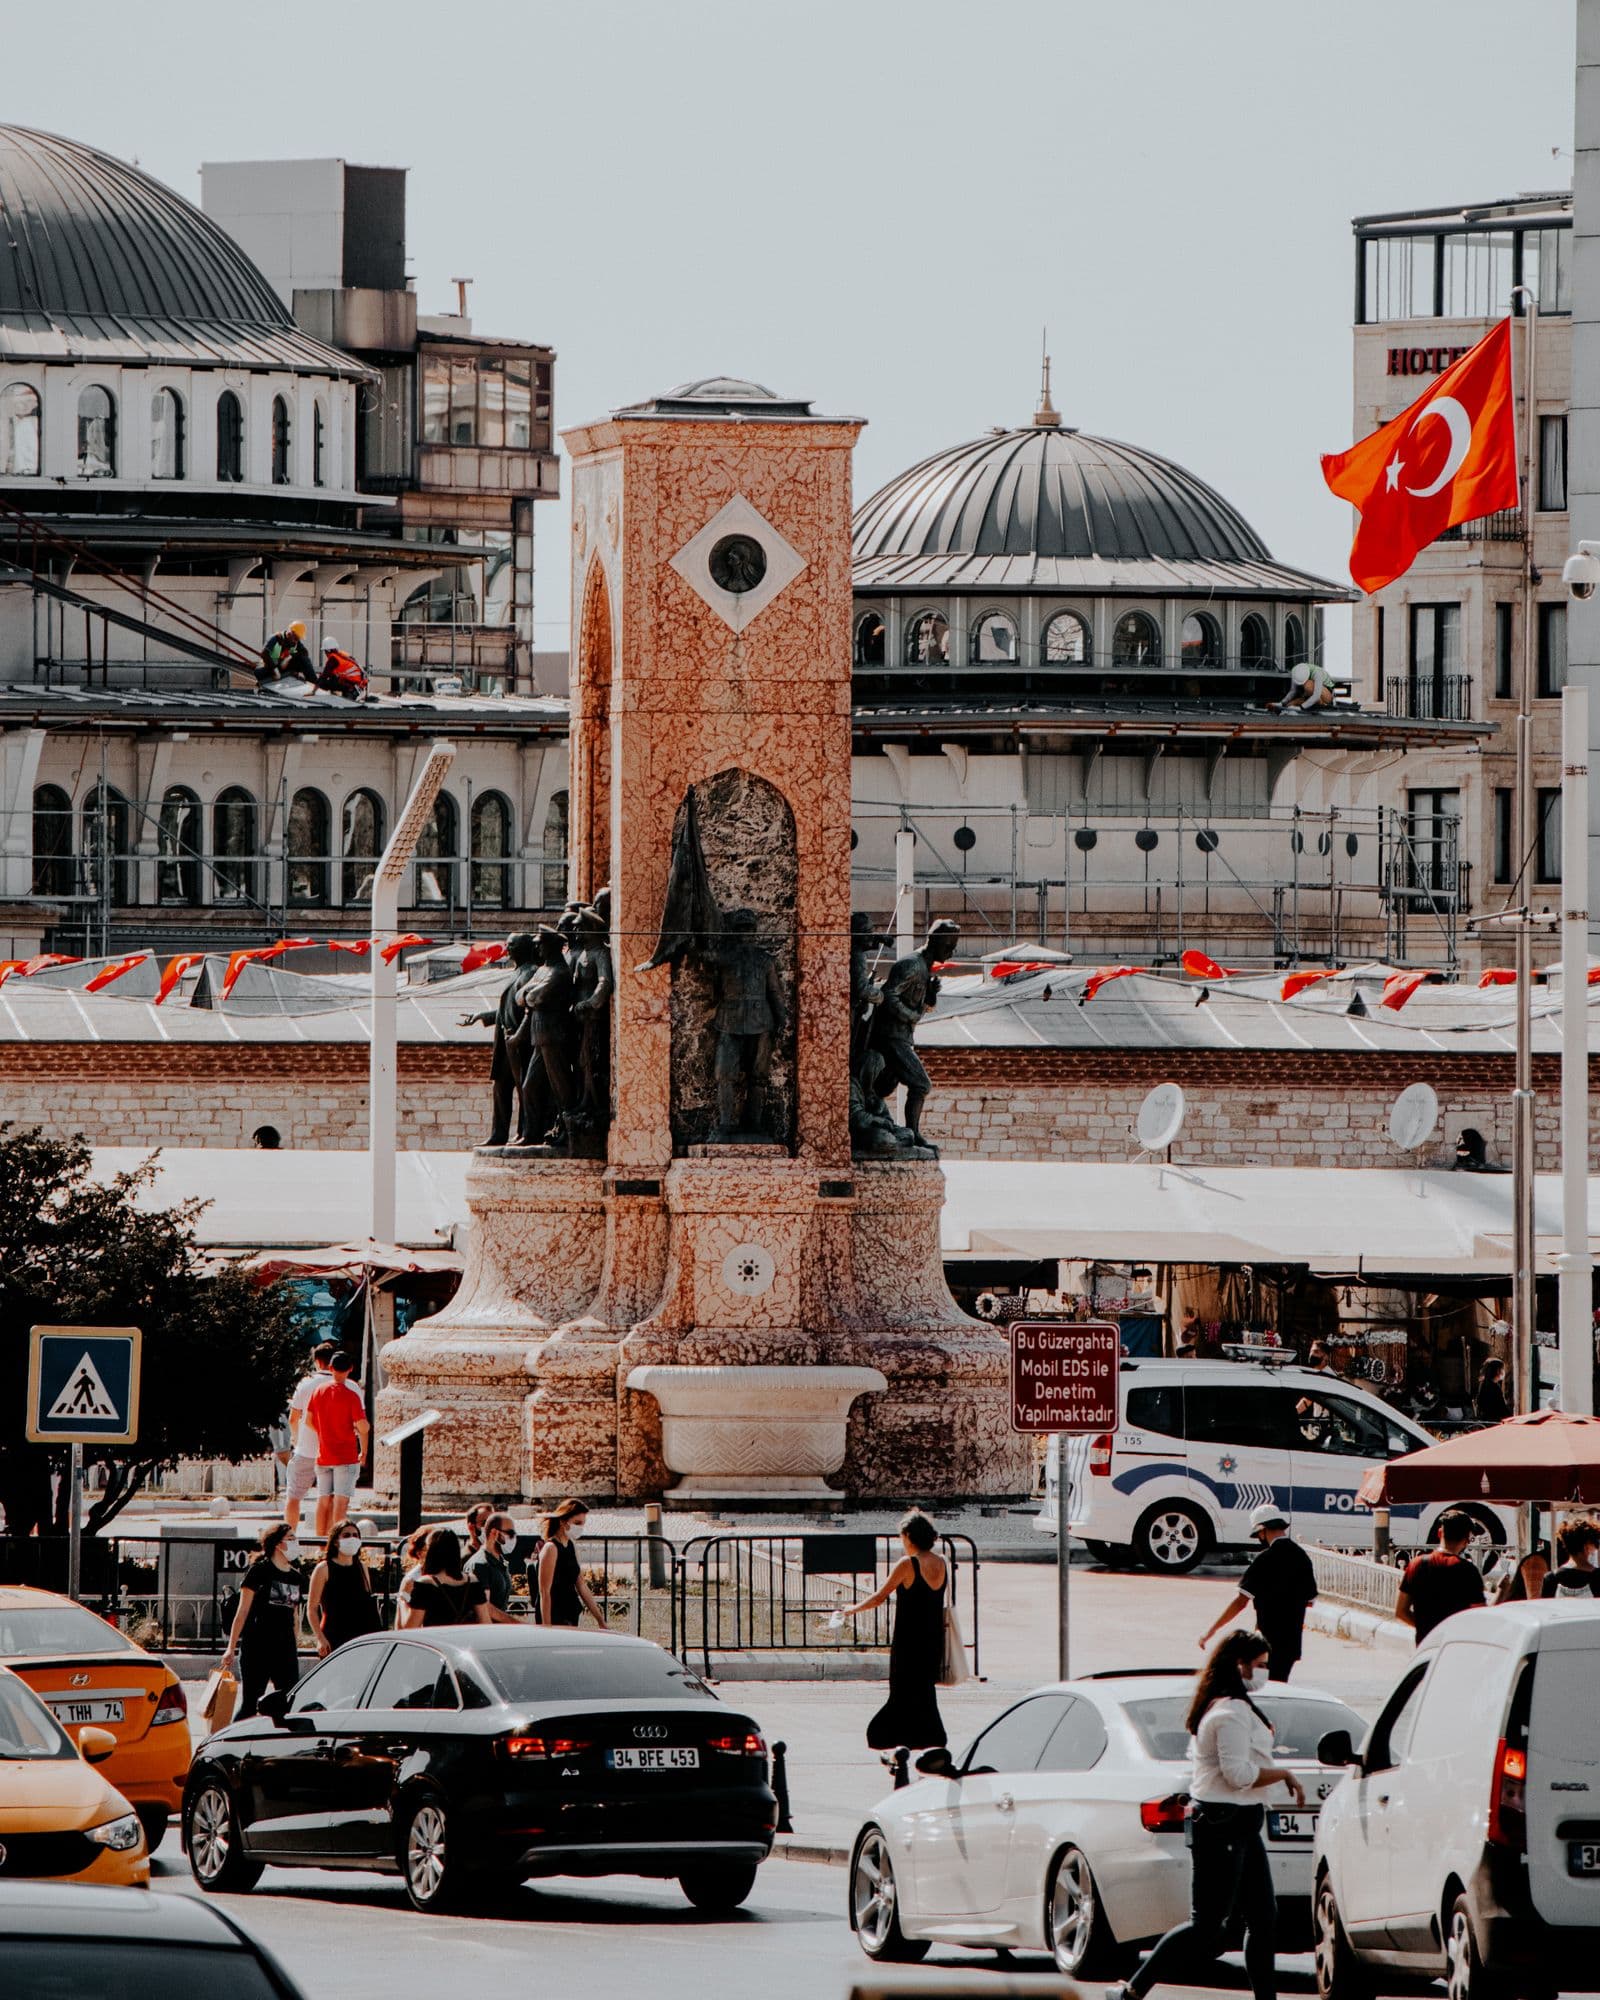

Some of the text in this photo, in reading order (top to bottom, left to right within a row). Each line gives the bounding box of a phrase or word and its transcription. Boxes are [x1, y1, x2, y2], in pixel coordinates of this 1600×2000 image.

[1387, 347, 1473, 375] HOTE
[1017, 1331, 1114, 1354] Bu Güzergahta
[1021, 1359, 1109, 1376] Mobil EDS ile
[1035, 1381, 1096, 1399] Denetim
[1016, 1404, 1113, 1426] Yapılmaktadır
[1124, 1436, 1142, 1445] 155
[68, 1704, 92, 1720] THH
[105, 1703, 120, 1719] 74
[615, 1750, 696, 1767] 34 BFE 453
[1280, 1815, 1299, 1833] 34
